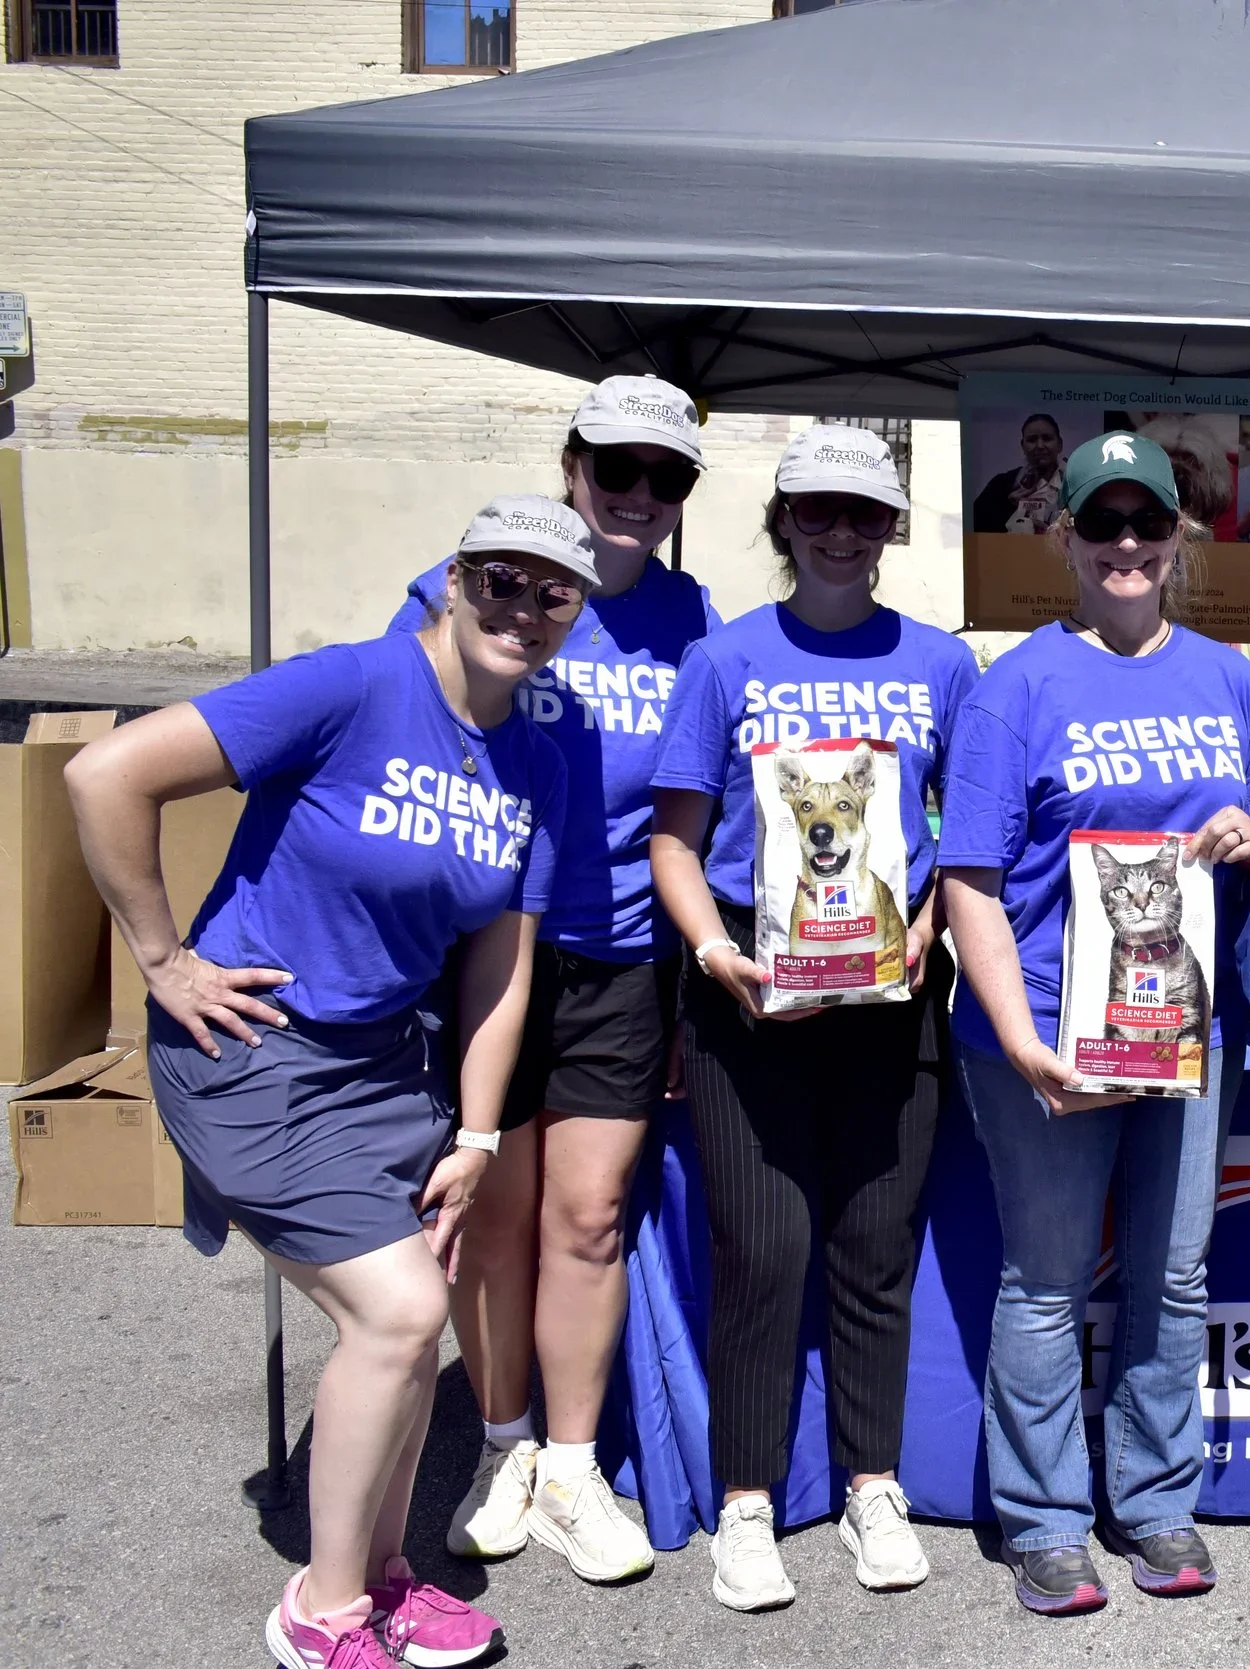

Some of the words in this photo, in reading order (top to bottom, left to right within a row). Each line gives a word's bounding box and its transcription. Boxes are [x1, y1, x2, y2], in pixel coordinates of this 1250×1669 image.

[1040, 389, 1063, 401] The
[1065, 390, 1100, 402] Street
[1102, 391, 1127, 405] Dog
[1128, 391, 1181, 405] Coalition
[1184, 393, 1221, 405] Would
[1224, 394, 1249, 406] Like
[619, 398, 661, 415] Street
[661, 405, 685, 428] Dog
[624, 410, 679, 427] COALITION
[814, 448, 856, 461] Street
[856, 450, 881, 470] Dog
[819, 458, 875, 470] COALITION
[503, 514, 548, 529] Street
[548, 519, 575, 544] Dog
[508, 525, 568, 542] COALITION
[1011, 594, 1036, 605] Hill's
[1036, 595, 1052, 605] Pet
[1031, 608, 1042, 616] to
[528, 657, 678, 701] CIENCE
[744, 679, 932, 717] SCIENCE
[519, 688, 563, 723] ID
[576, 697, 667, 735] THA
[738, 713, 810, 754] DID
[1066, 715, 1241, 754] SCIENCE
[1062, 753, 1142, 794] DID
[381, 757, 533, 837] SCIENCE
[359, 795, 442, 846] DID
[823, 906, 852, 919] Hill's
[804, 923, 847, 934] SCIENCE
[849, 921, 871, 931] DIET
[776, 957, 808, 967] ADULT
[810, 958, 827, 967] 1-6
[1132, 992, 1160, 1004] Hill's
[1111, 1008, 1153, 1019] SCIENCE
[1155, 1010, 1178, 1020] DIET
[1078, 1041, 1113, 1051] ADULT
[1114, 1043, 1130, 1052] 1-6
[24, 1126, 48, 1136] Hill's
[64, 1211, 103, 1220] PC317341
